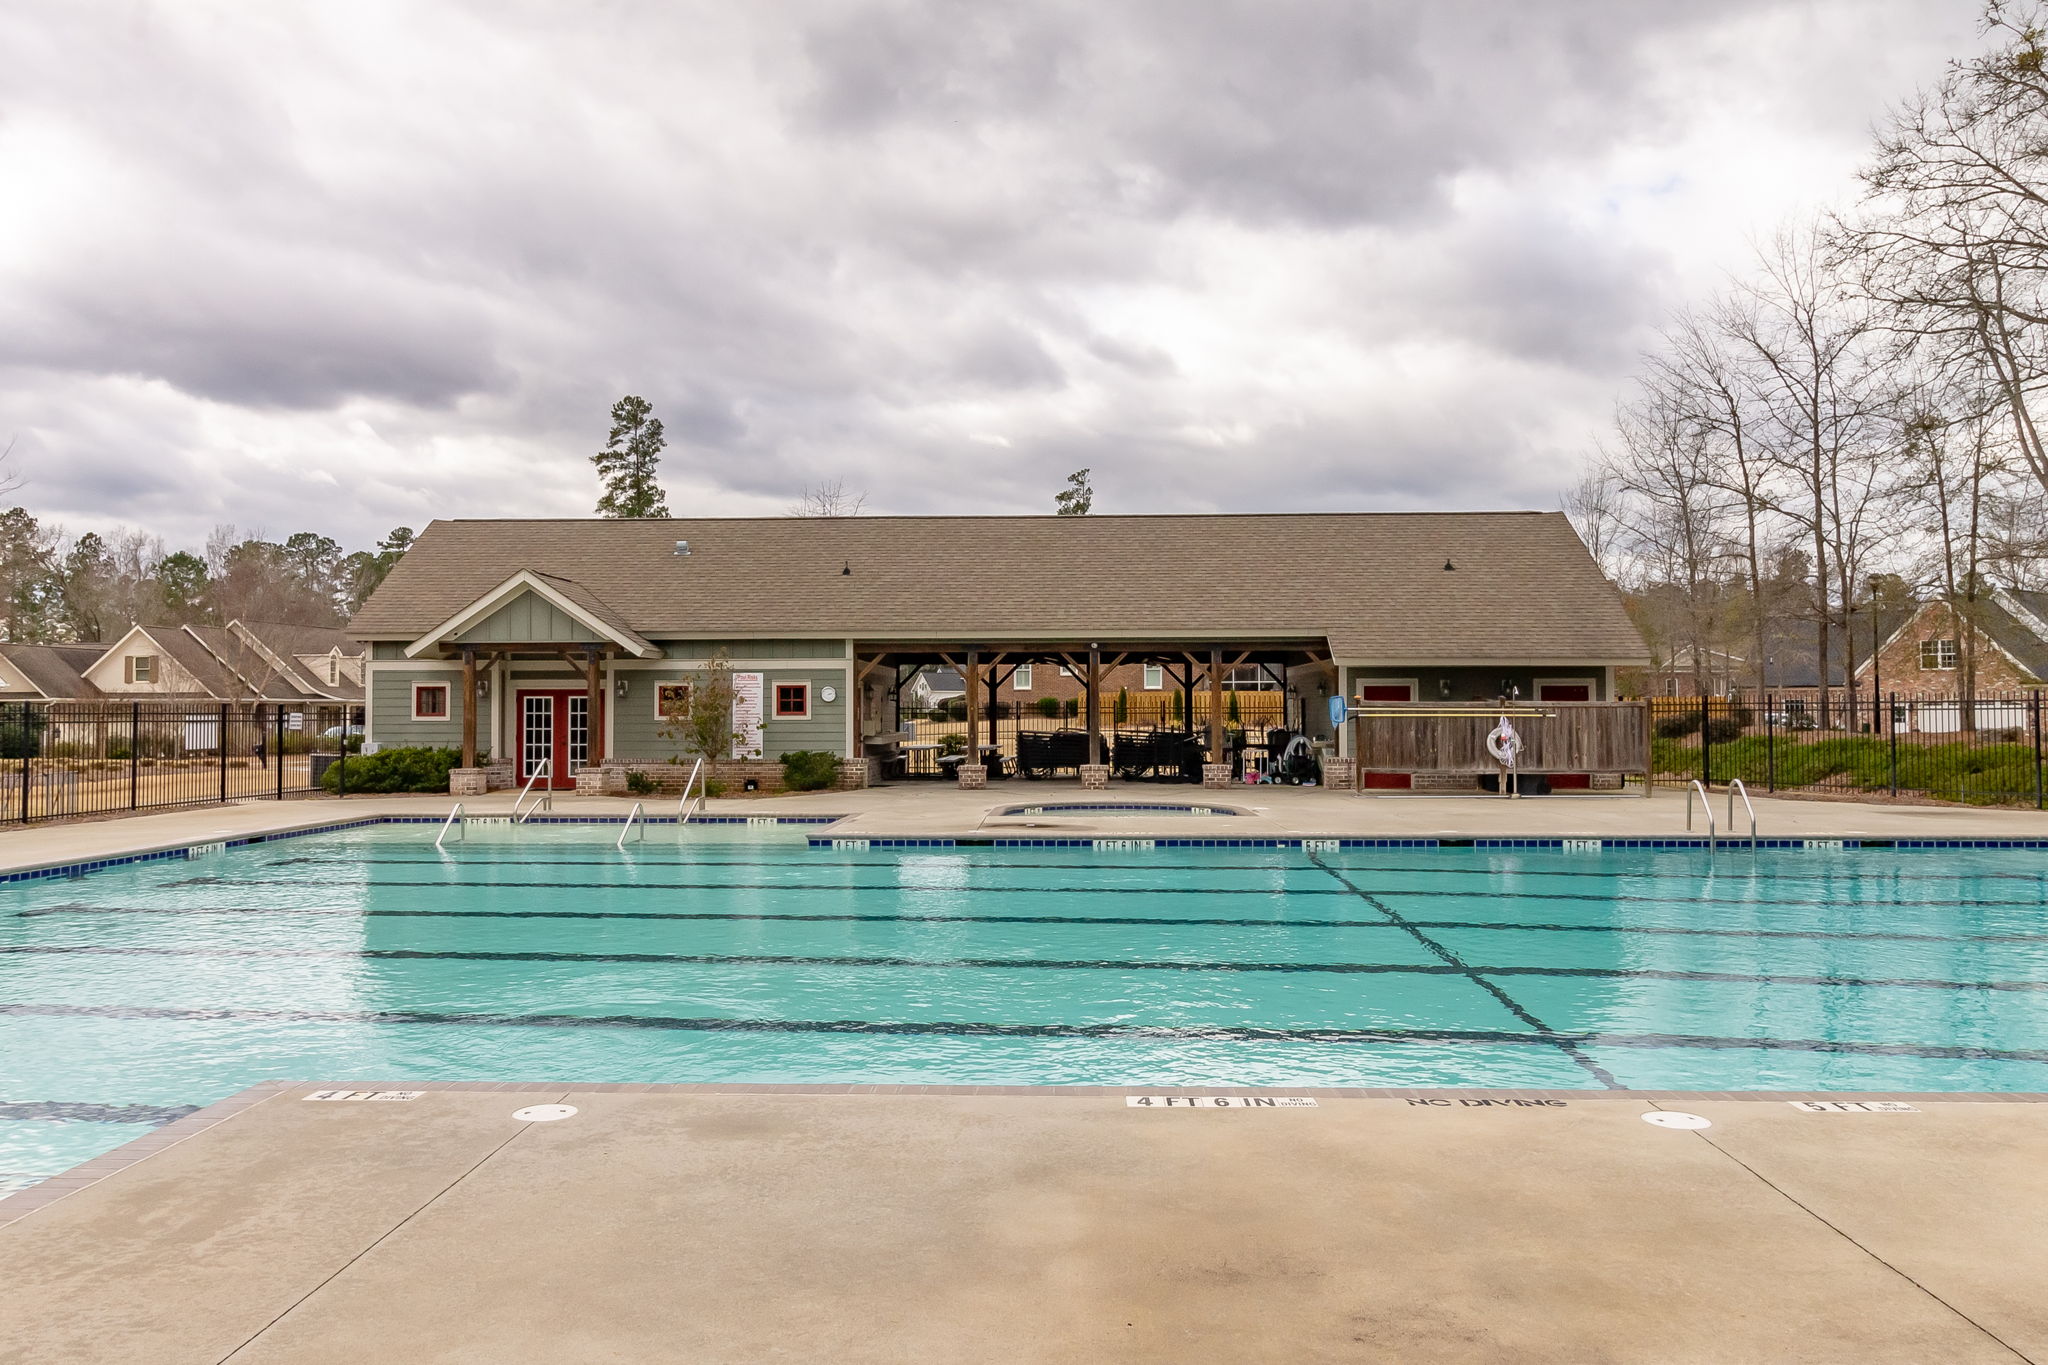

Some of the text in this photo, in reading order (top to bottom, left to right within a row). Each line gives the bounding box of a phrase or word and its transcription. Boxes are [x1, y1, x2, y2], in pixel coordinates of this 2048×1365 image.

[845, 840, 857, 850] FT
[1106, 840, 1117, 850] FT
[1131, 840, 1141, 850] IN
[1315, 840, 1327, 850] FT
[1576, 840, 1588, 850] FT
[317, 1091, 387, 1099] 4 FT
[1137, 1097, 1275, 1106] 4 FT 6 IN
[1459, 1099, 1567, 1107] DIVING
[1802, 1102, 1873, 1111] 5 FT
